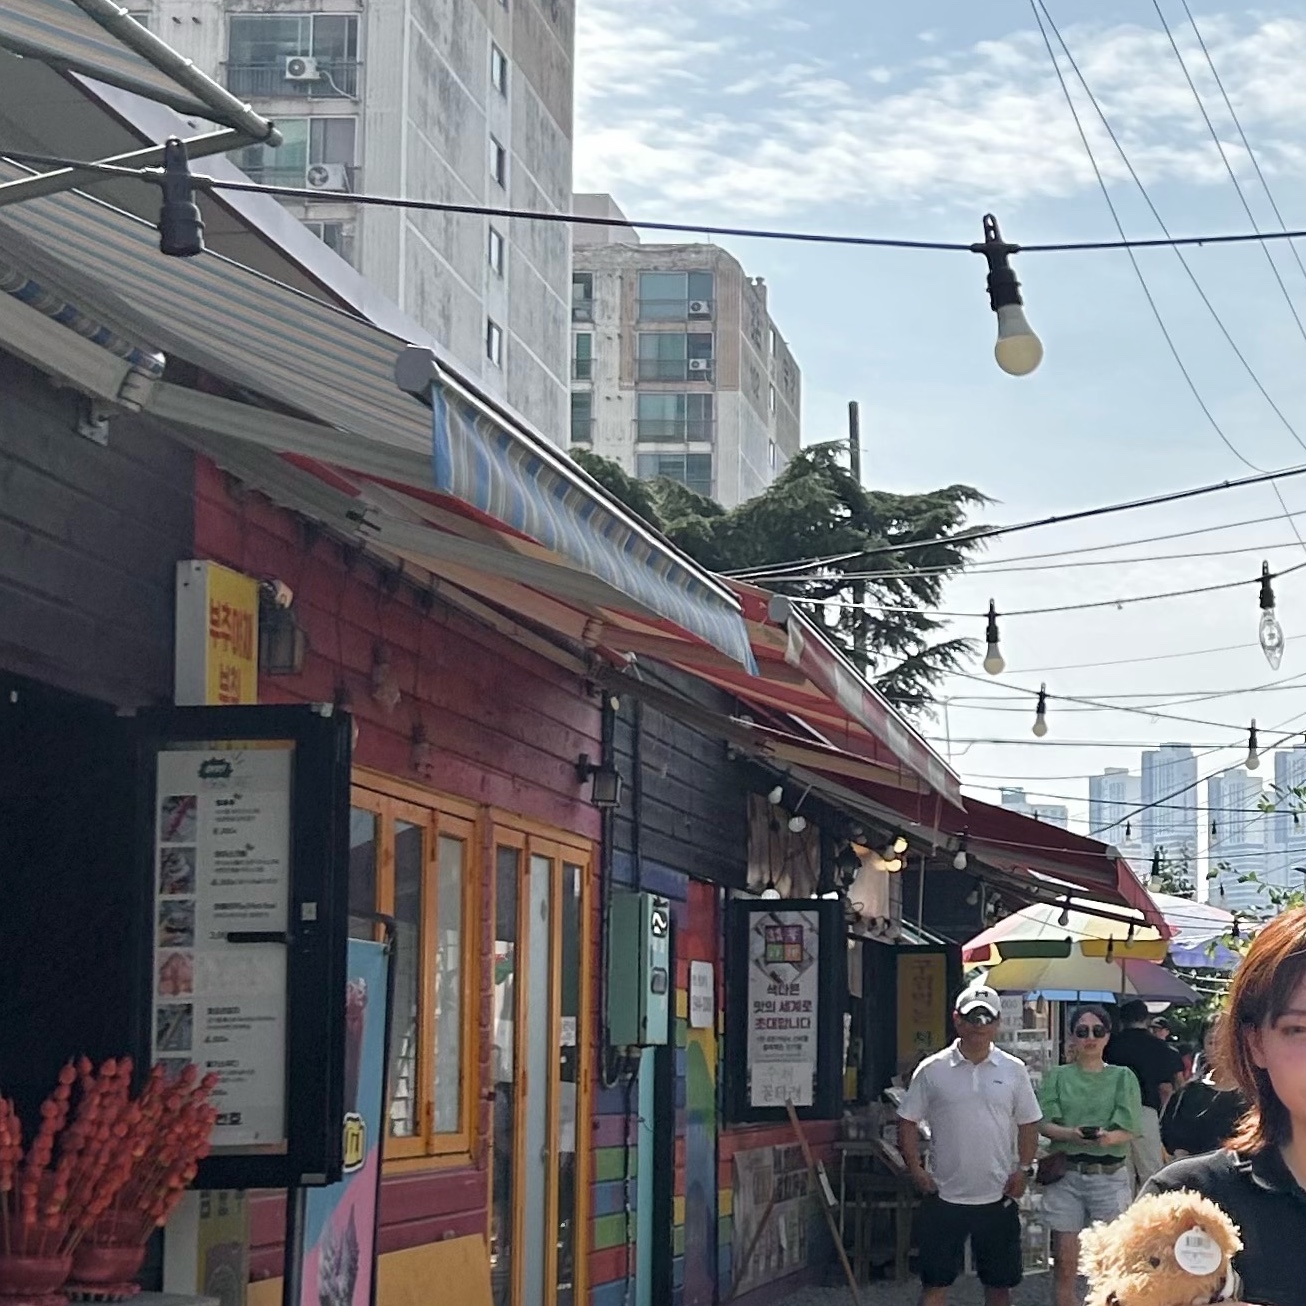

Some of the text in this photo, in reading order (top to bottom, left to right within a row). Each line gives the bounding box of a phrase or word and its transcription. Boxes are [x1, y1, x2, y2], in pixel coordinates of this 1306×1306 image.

[767, 983, 800, 996] 색다른
[753, 1000, 813, 1013] 맛의 세계로
[755, 1017, 811, 1030] 초대합니다
